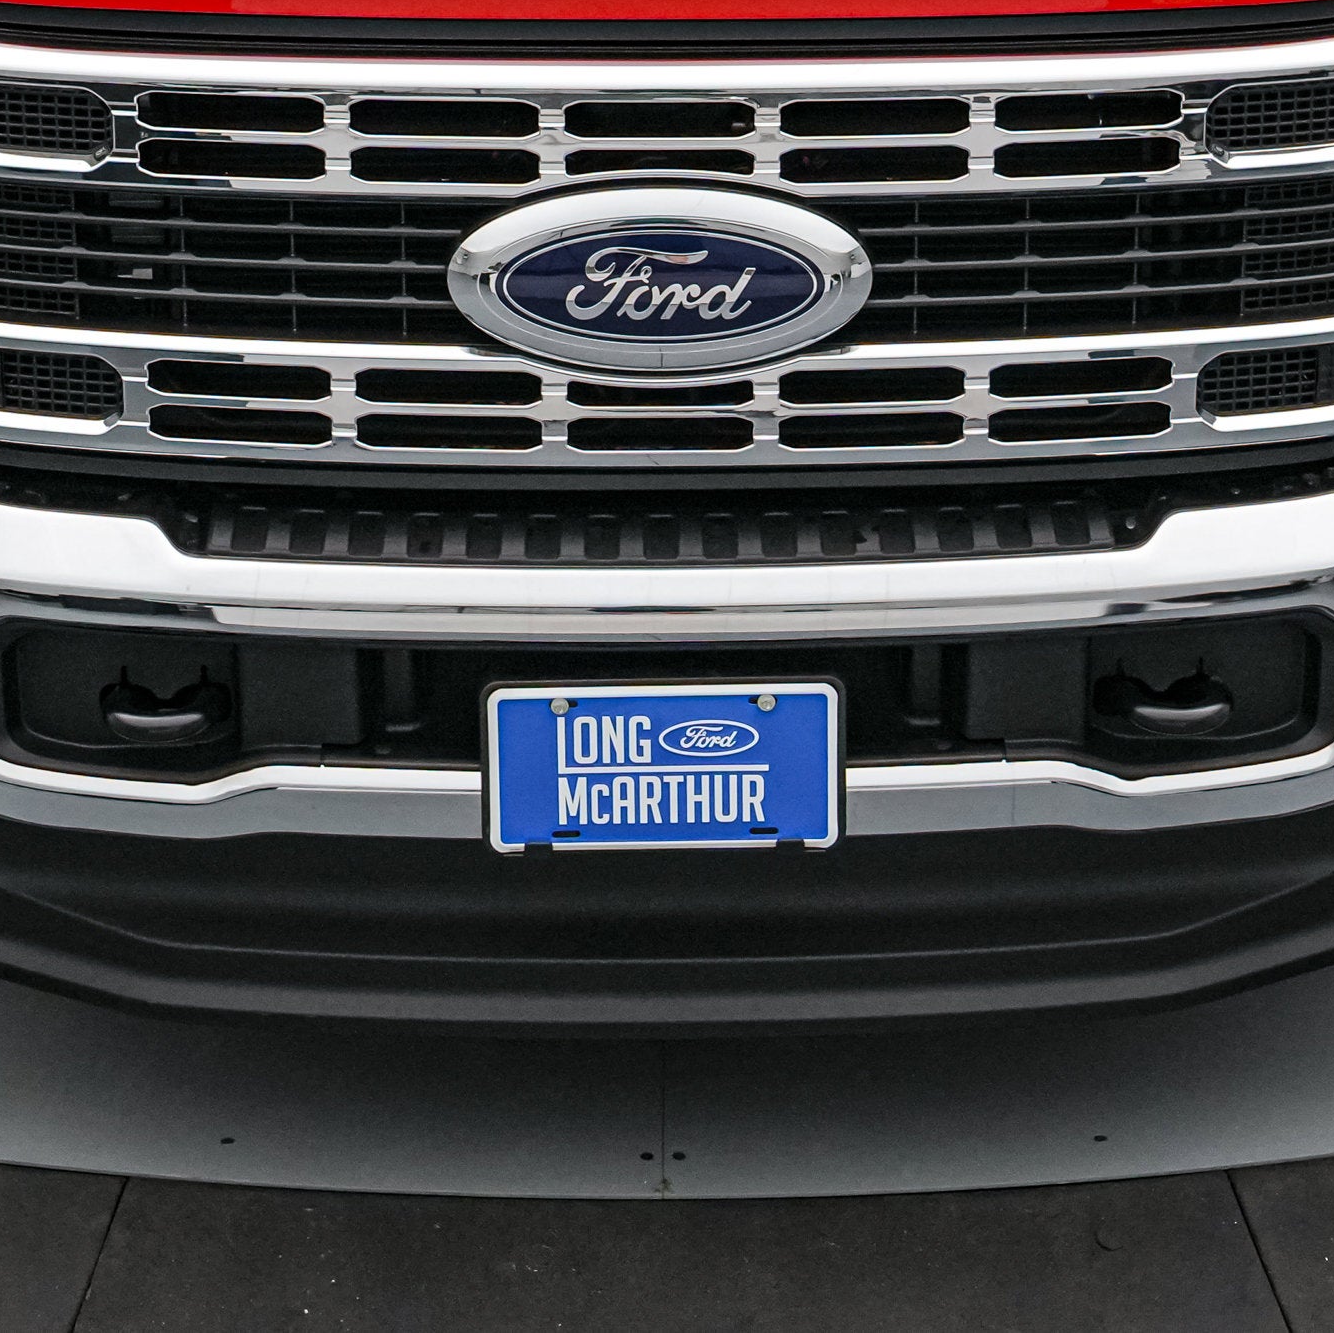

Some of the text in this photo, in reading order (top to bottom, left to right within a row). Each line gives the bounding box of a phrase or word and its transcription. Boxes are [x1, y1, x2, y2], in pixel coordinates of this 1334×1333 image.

[566, 246, 752, 321] Ford
[557, 715, 737, 774] LONG Ford
[558, 773, 765, 826] McARTHUR
